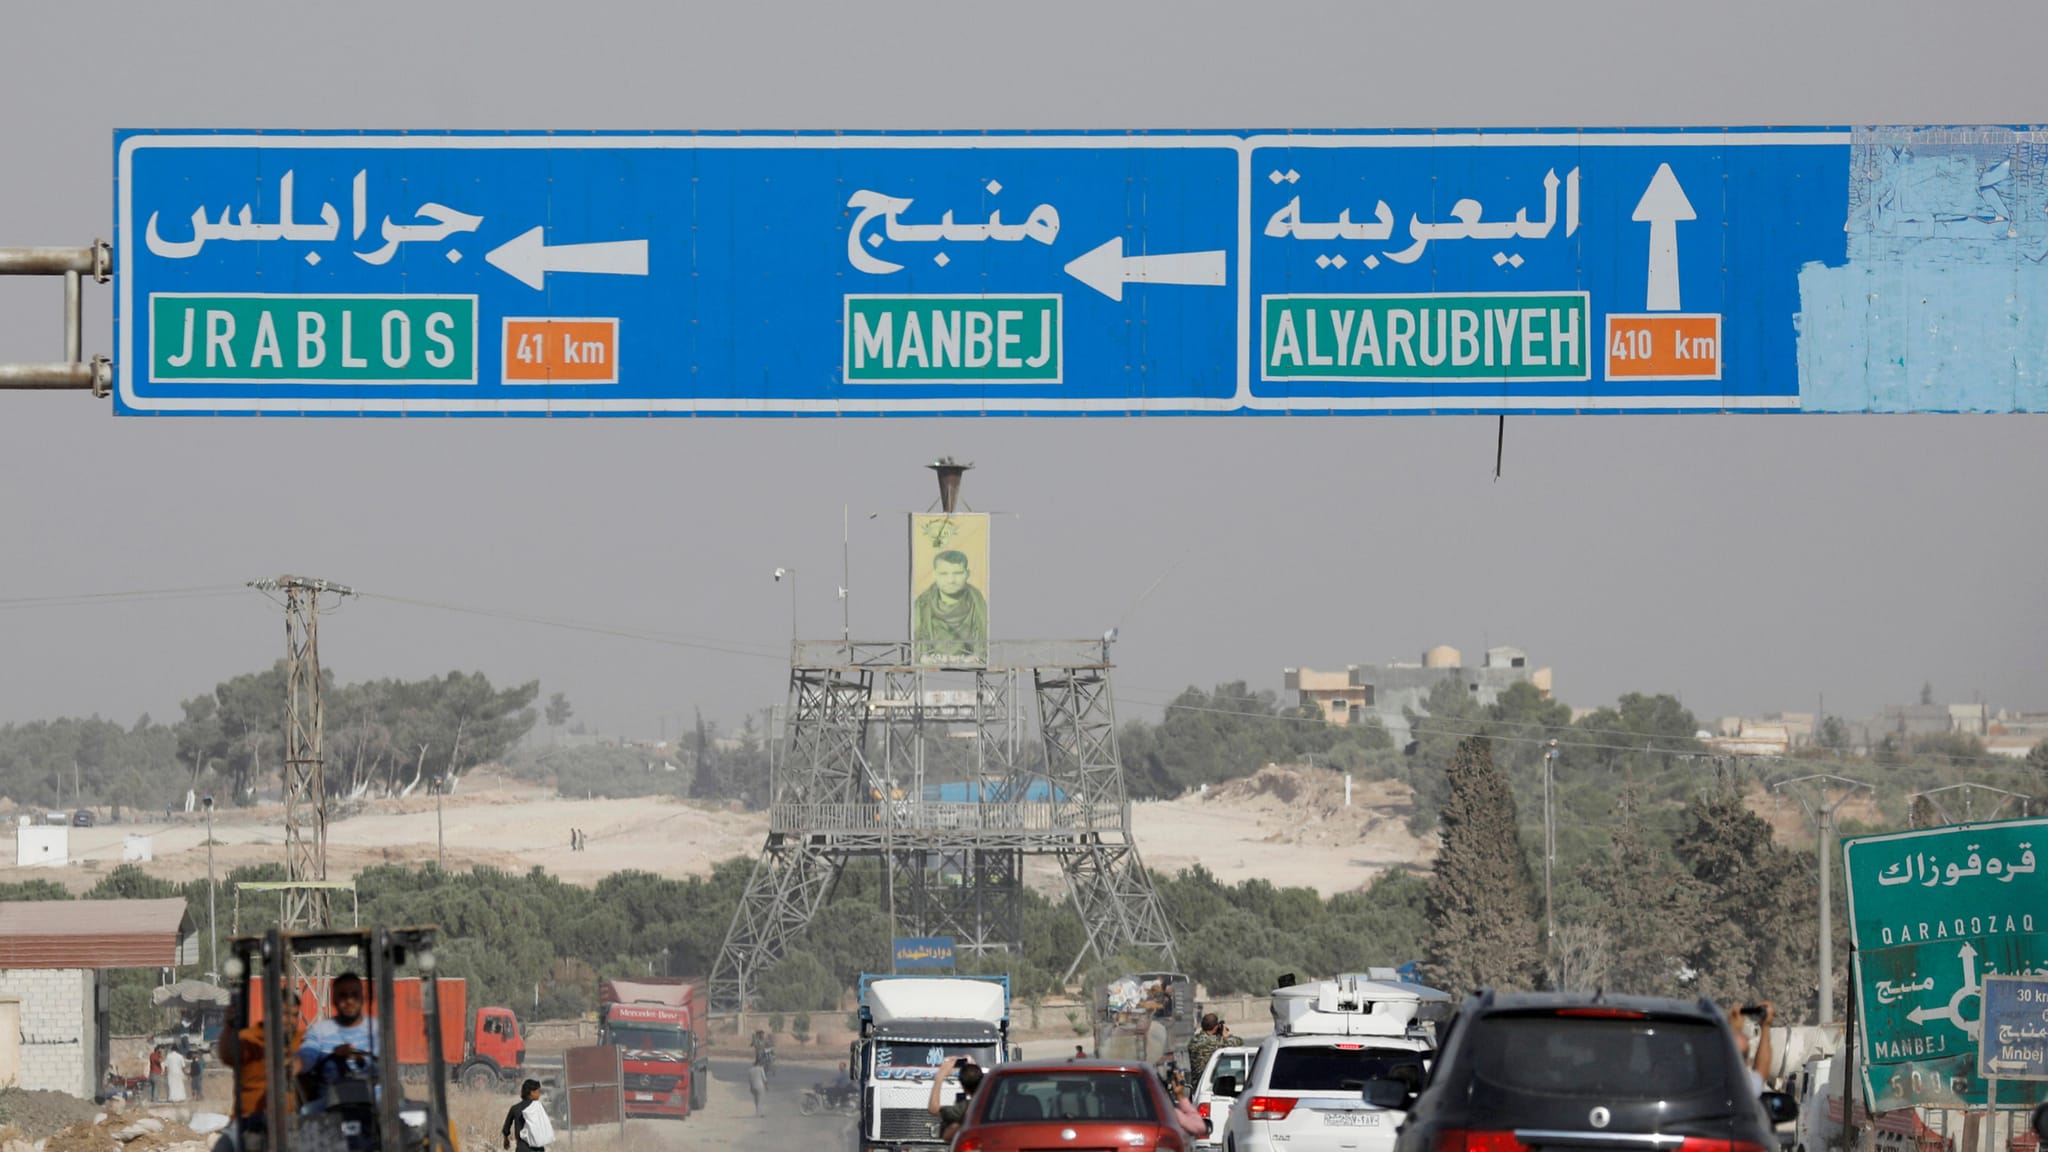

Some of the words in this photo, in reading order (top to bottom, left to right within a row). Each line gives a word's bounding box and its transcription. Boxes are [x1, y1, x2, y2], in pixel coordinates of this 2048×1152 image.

[145, 168, 485, 266] جرابلس
[846, 179, 1061, 275] منبج
[1263, 166, 1581, 270] اليعربية
[167, 307, 456, 369] JRABLOS
[516, 332, 543, 364] 41
[563, 332, 606, 365] km
[853, 309, 1051, 369] MANBEJ
[1270, 307, 1580, 367] ALYARUBIYEH
[1610, 329, 1653, 360] 410
[1675, 329, 1716, 361] km
[1878, 844, 1982, 887] قوزاك
[1986, 841, 2036, 882] قره
[1882, 914, 2034, 945] QARAQOZAQ
[1875, 972, 1935, 1004] منبج
[2017, 989, 2032, 1002] 30
[1875, 1034, 1946, 1059] MANBEJ
[2002, 1045, 2044, 1064] Mnbej
